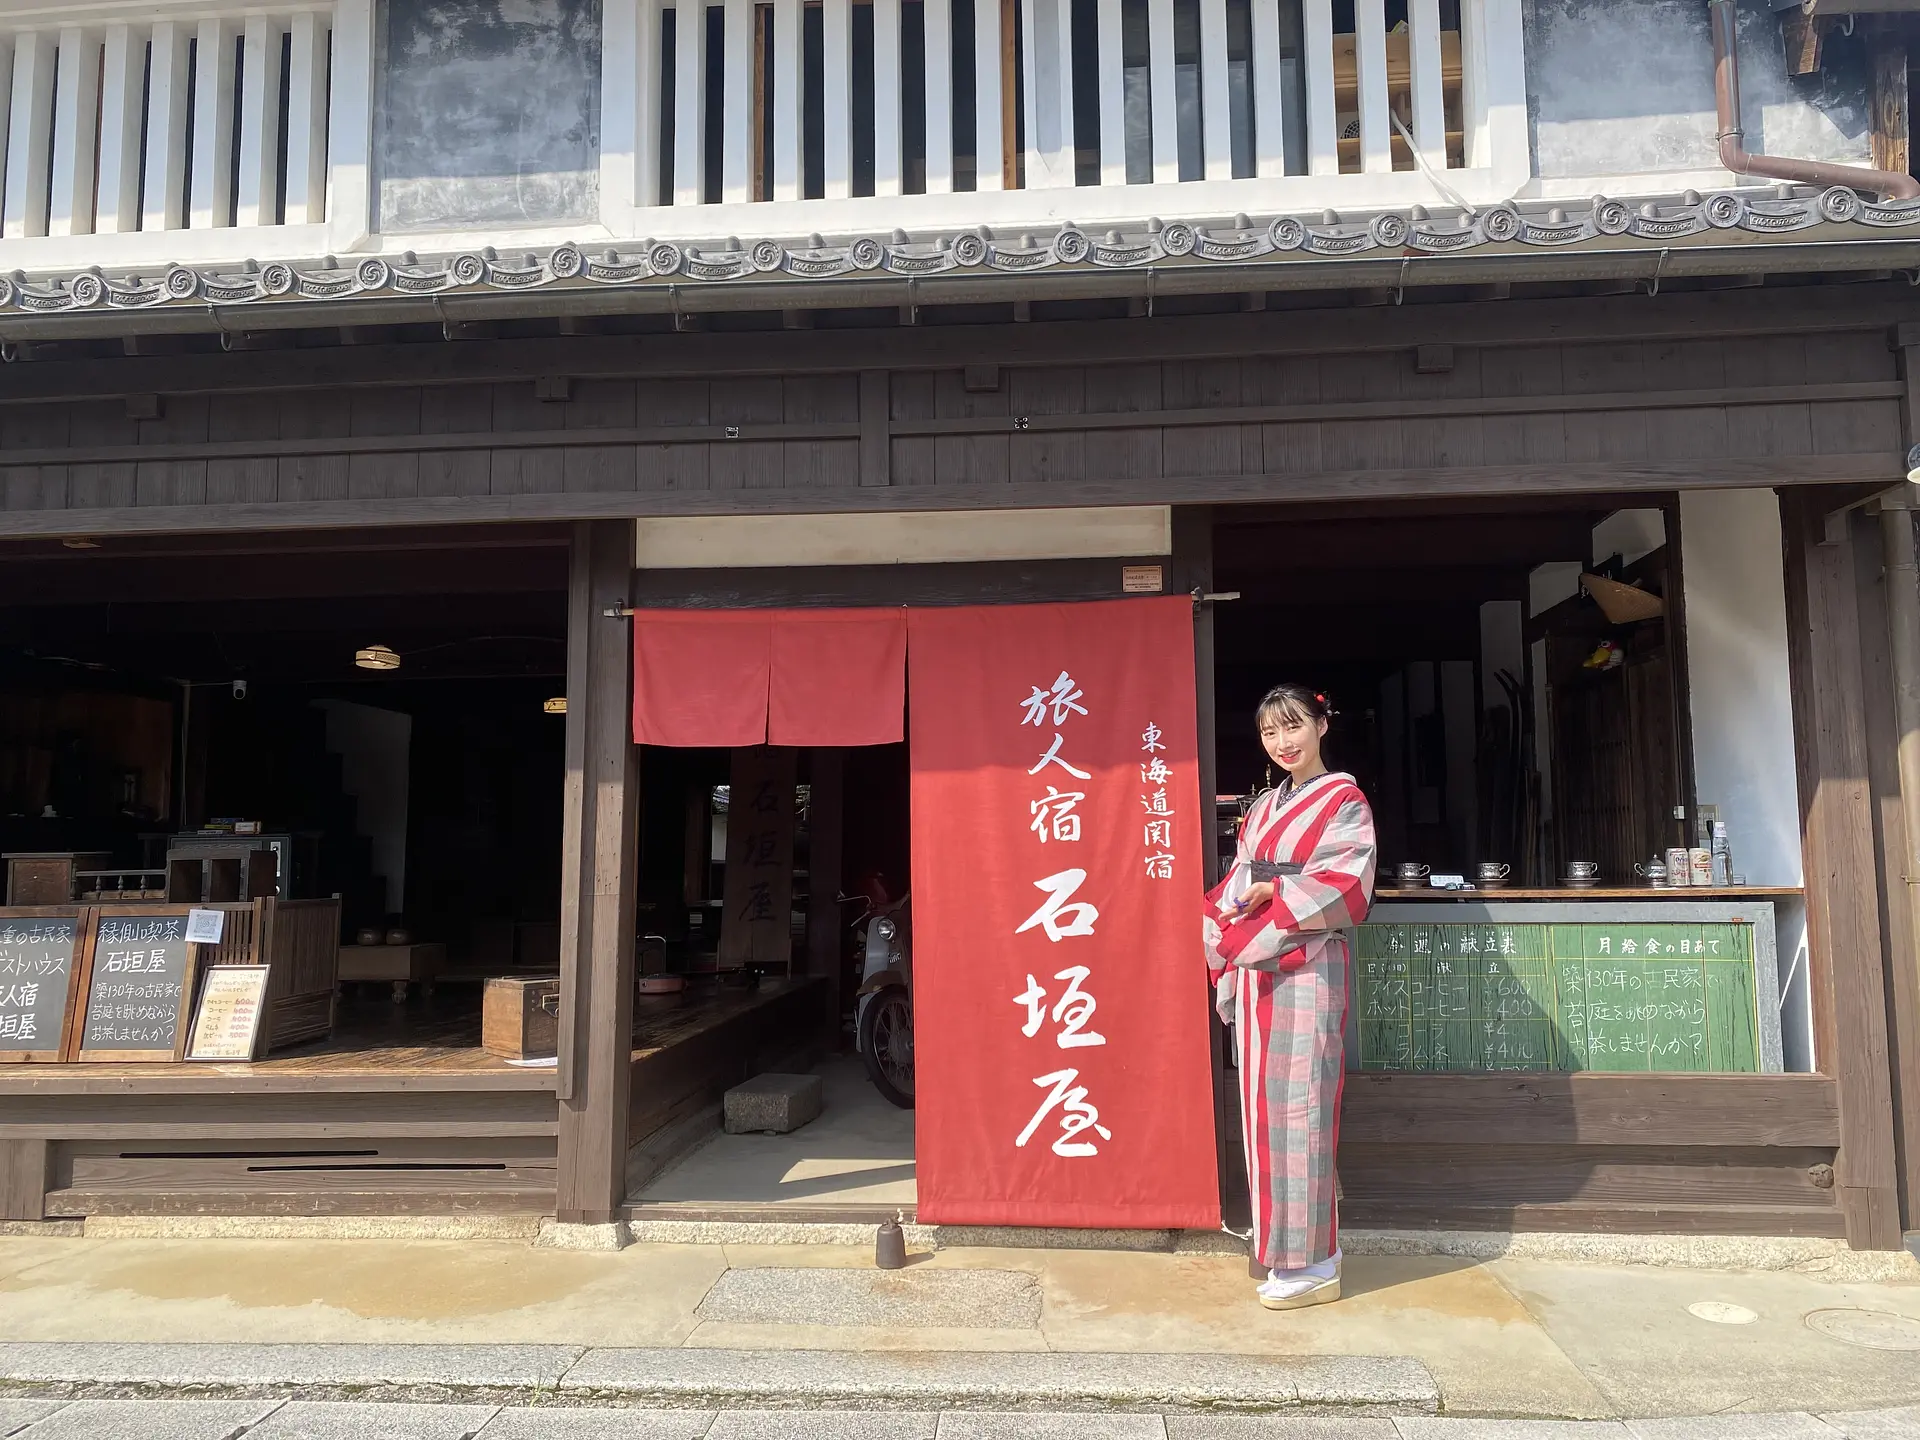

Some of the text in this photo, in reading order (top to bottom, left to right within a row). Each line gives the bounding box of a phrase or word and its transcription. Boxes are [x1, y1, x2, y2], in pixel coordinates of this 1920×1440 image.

[1140, 721, 1174, 881] 東海道関宿
[0, 923, 71, 945] 重の古民家
[98, 919, 180, 944] 縁側喫茶
[1598, 936, 1720, 955] 月給食の目あて
[101, 948, 167, 974] 石垣屋
[1367, 978, 1466, 997] アイスコーヒー
[1366, 999, 1467, 1019] ホットコーヒー
[1398, 1022, 1444, 1040] コーラ
[1397, 1042, 1449, 1061] ラムネ
